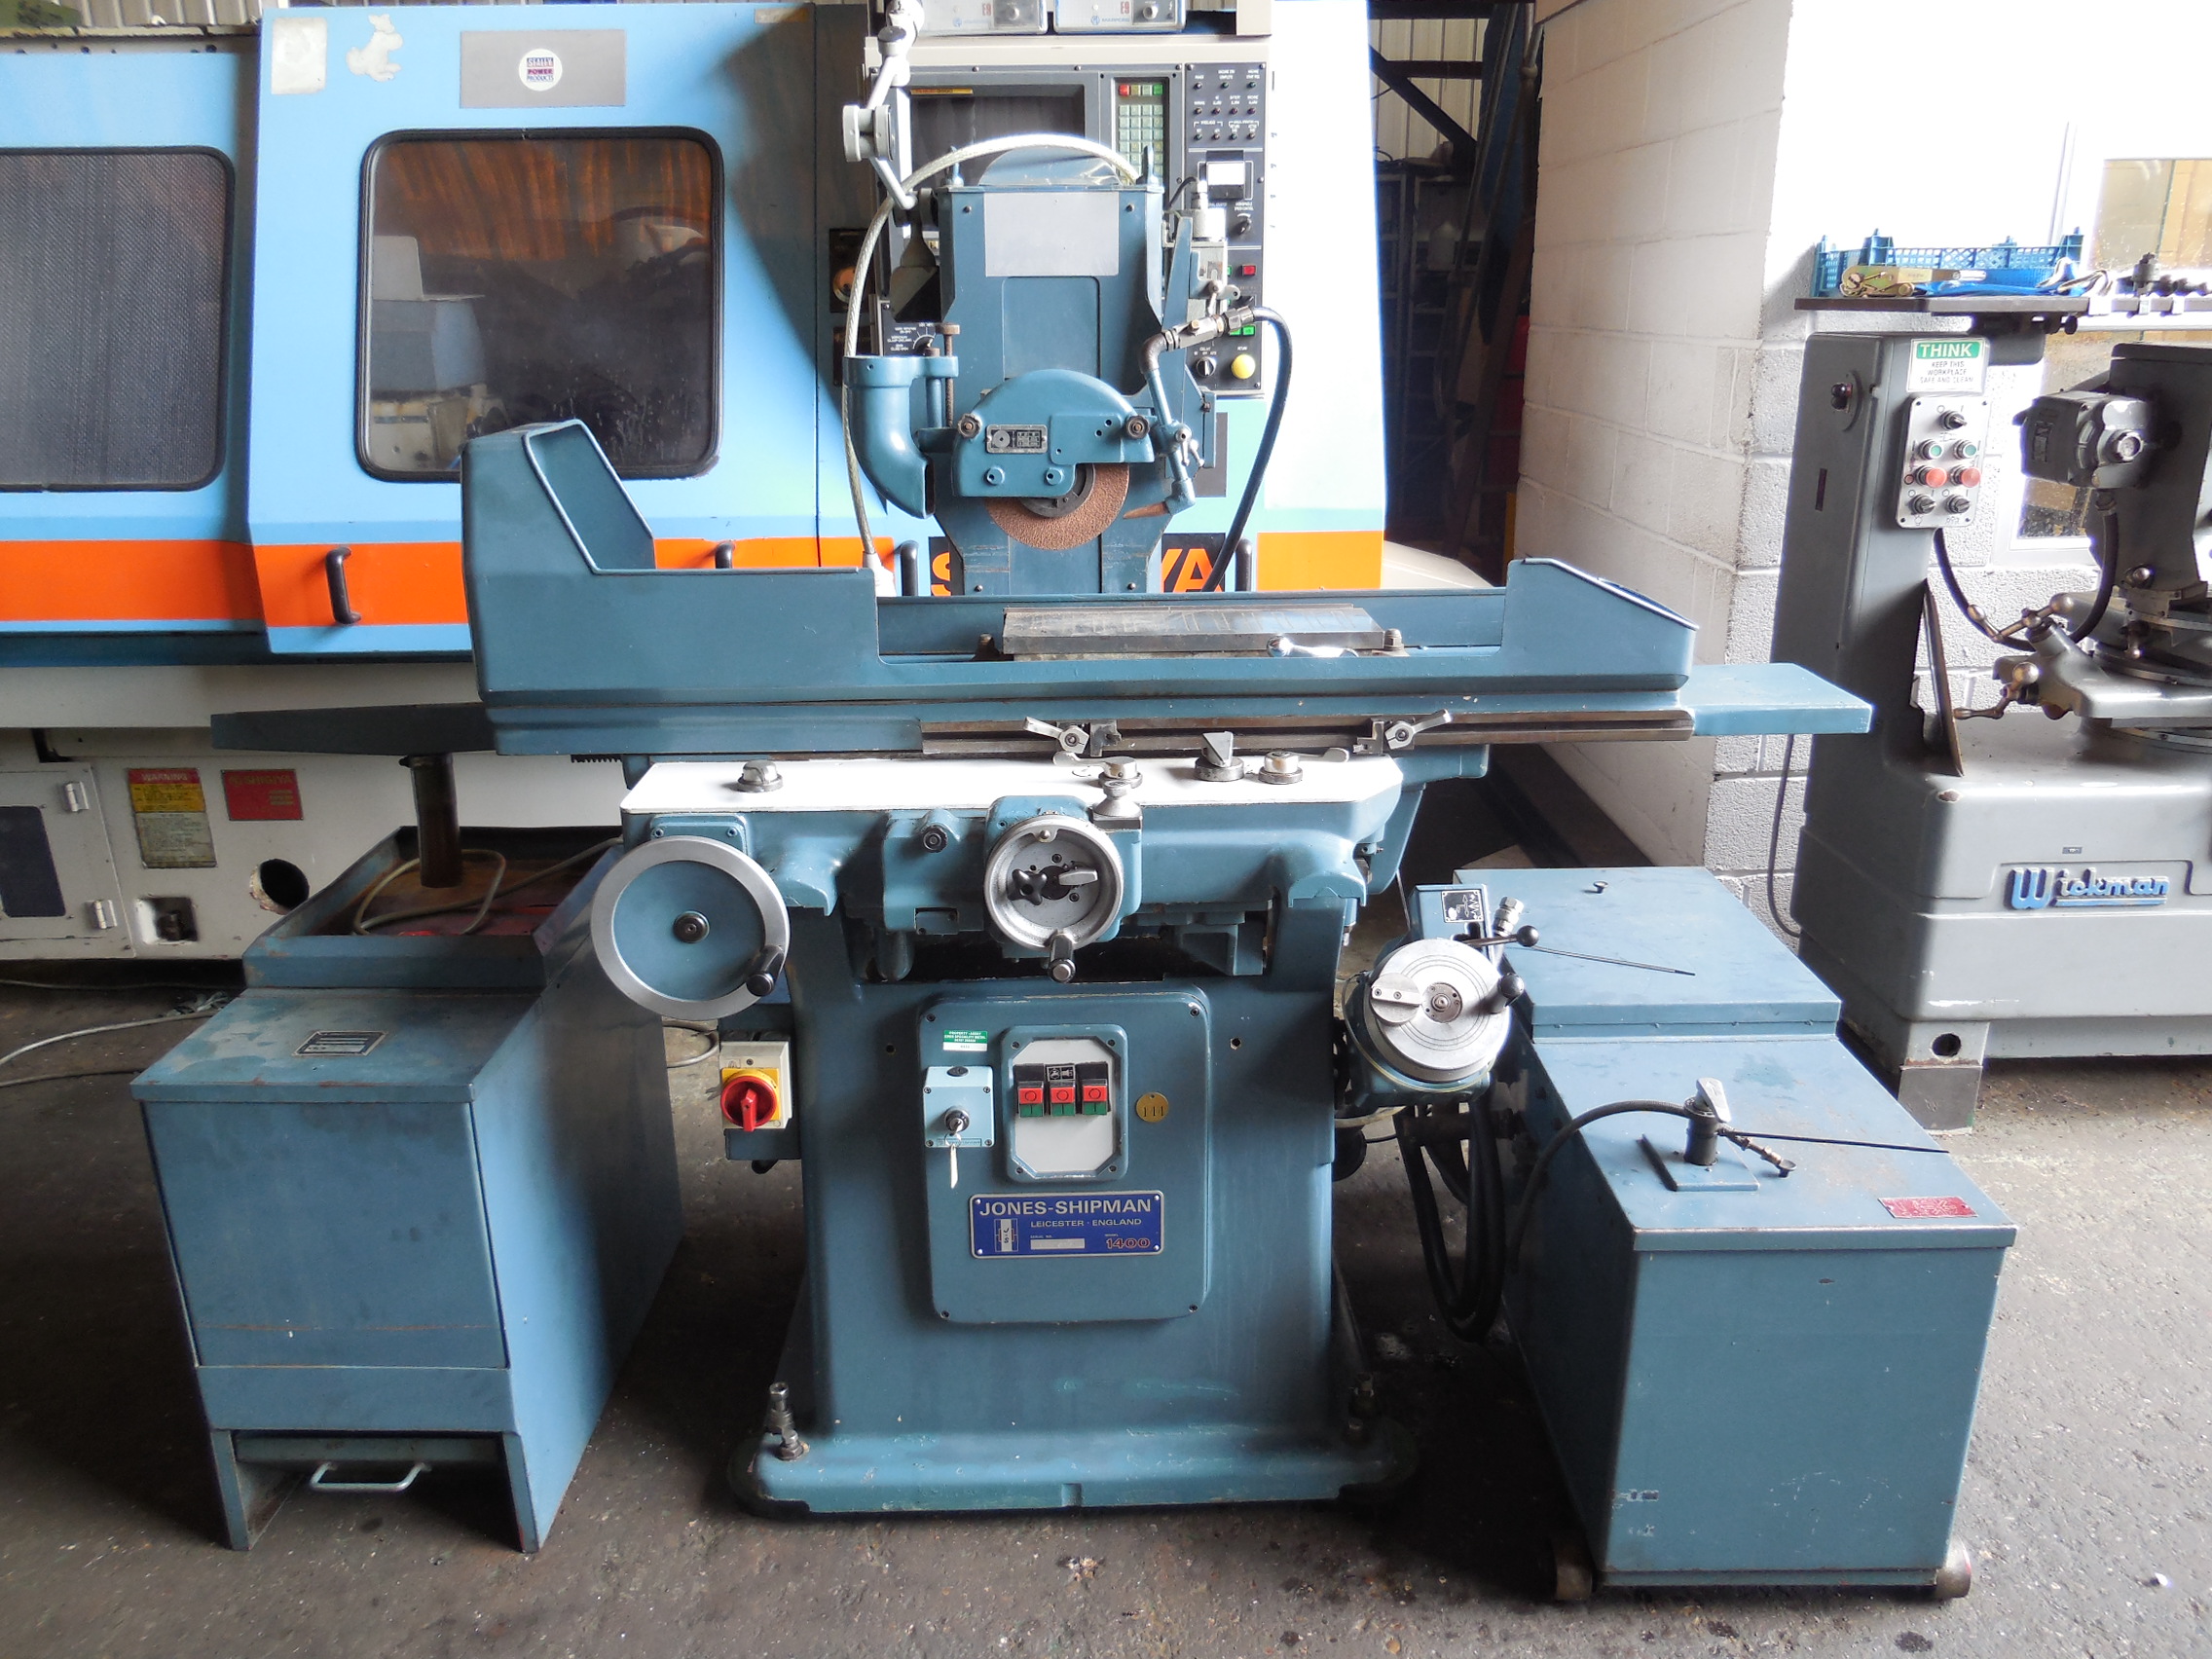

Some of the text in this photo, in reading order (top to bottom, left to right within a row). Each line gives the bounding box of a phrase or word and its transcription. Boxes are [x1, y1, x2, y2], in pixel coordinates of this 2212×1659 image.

[1920, 343, 1972, 358] THINK
[2009, 866, 2170, 910] Wickman
[979, 1198, 1151, 1216] JONES-SHIPMAN
[1091, 1218, 1142, 1227] ENGLAND
[1106, 1237, 1151, 1250] 1400
